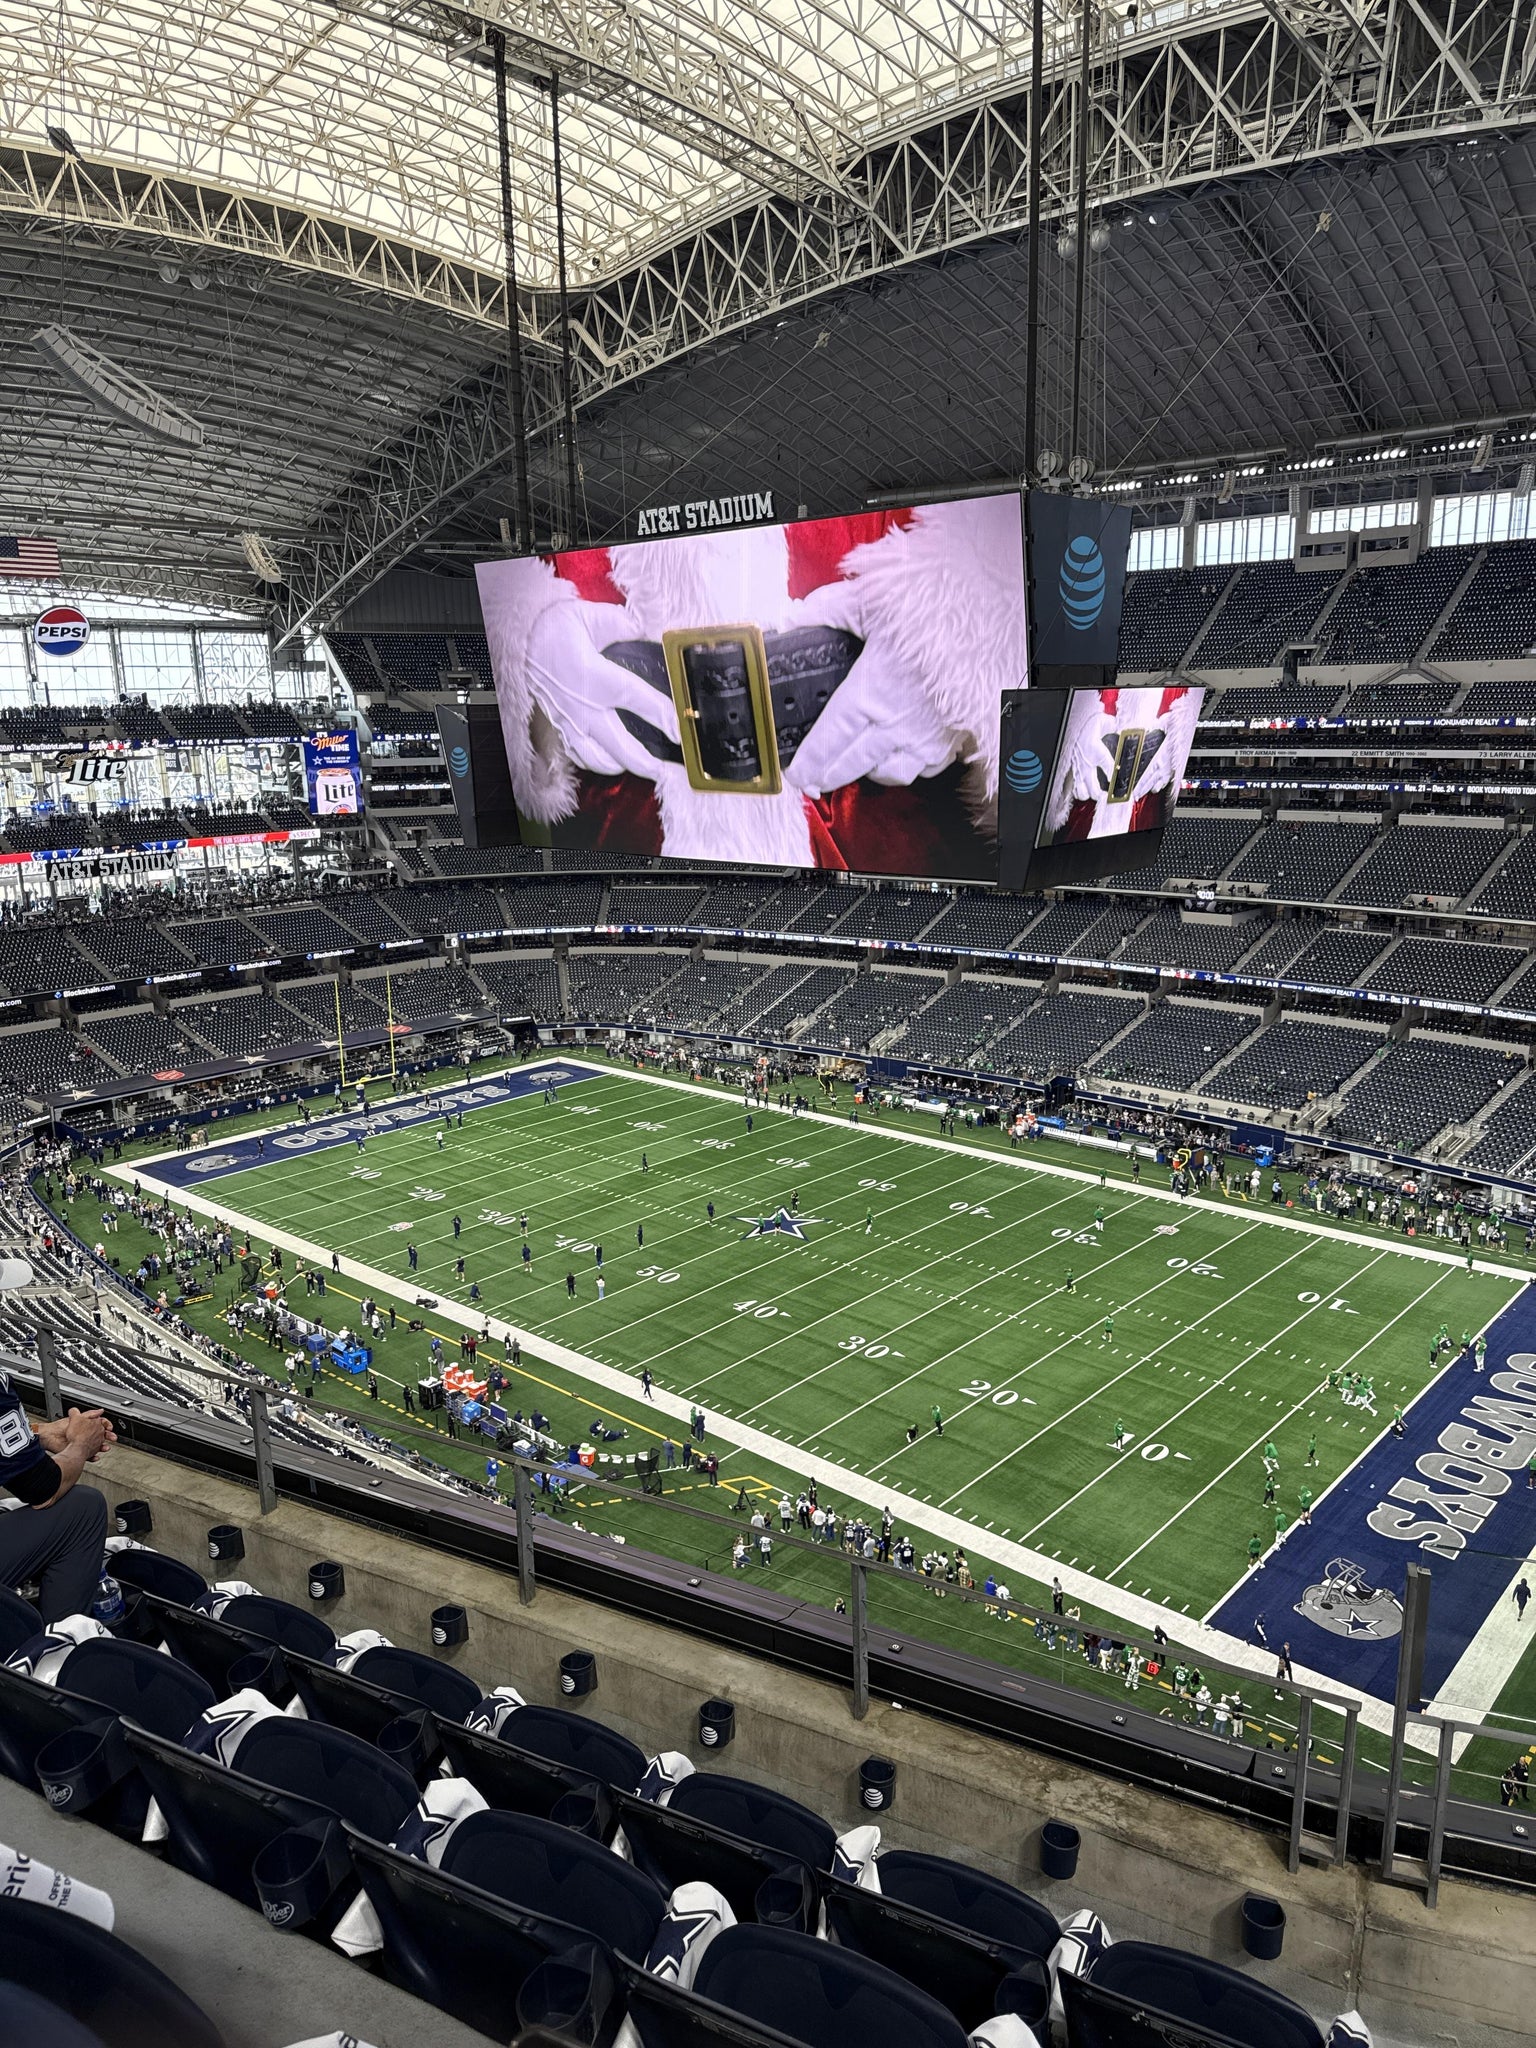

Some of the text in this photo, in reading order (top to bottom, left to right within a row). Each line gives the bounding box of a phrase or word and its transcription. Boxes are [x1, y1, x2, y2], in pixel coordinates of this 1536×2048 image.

[637, 491, 775, 536] AT&T STADIUM
[37, 625, 87, 639] PEPSI
[1345, 719, 1368, 727] THE
[1371, 719, 1401, 727] STAR
[1433, 718, 1474, 726] MONUMENT
[1474, 718, 1500, 726] REALTY
[310, 735, 349, 751] Miller
[331, 743, 350, 752] TIME
[67, 759, 127, 786] Lite
[1246, 781, 1267, 789] THE
[1270, 781, 1299, 789] STAR
[1404, 784, 1418, 792] Nov.
[1445, 785, 1455, 793] 24
[1500, 786, 1521, 795] PHOTO
[323, 783, 354, 804] Lite
[82, 846, 104, 856] 90:00
[49, 853, 179, 881] AT&T STADIUM
[236, 959, 281, 971] Blockchain.com
[153, 971, 202, 984] Blockchain.com
[1255, 979, 1279, 988] STAR
[63, 984, 116, 998] Blockchain.com
[272, 1085, 511, 1149] COWBOYS
[348, 1165, 383, 1180] 10
[408, 1188, 447, 1202] 20
[477, 1210, 516, 1226] 30
[554, 1237, 596, 1253] 40
[636, 1265, 681, 1284] 50
[732, 1299, 780, 1319] 40
[837, 1334, 891, 1359] 30
[958, 1379, 1019, 1406] 20
